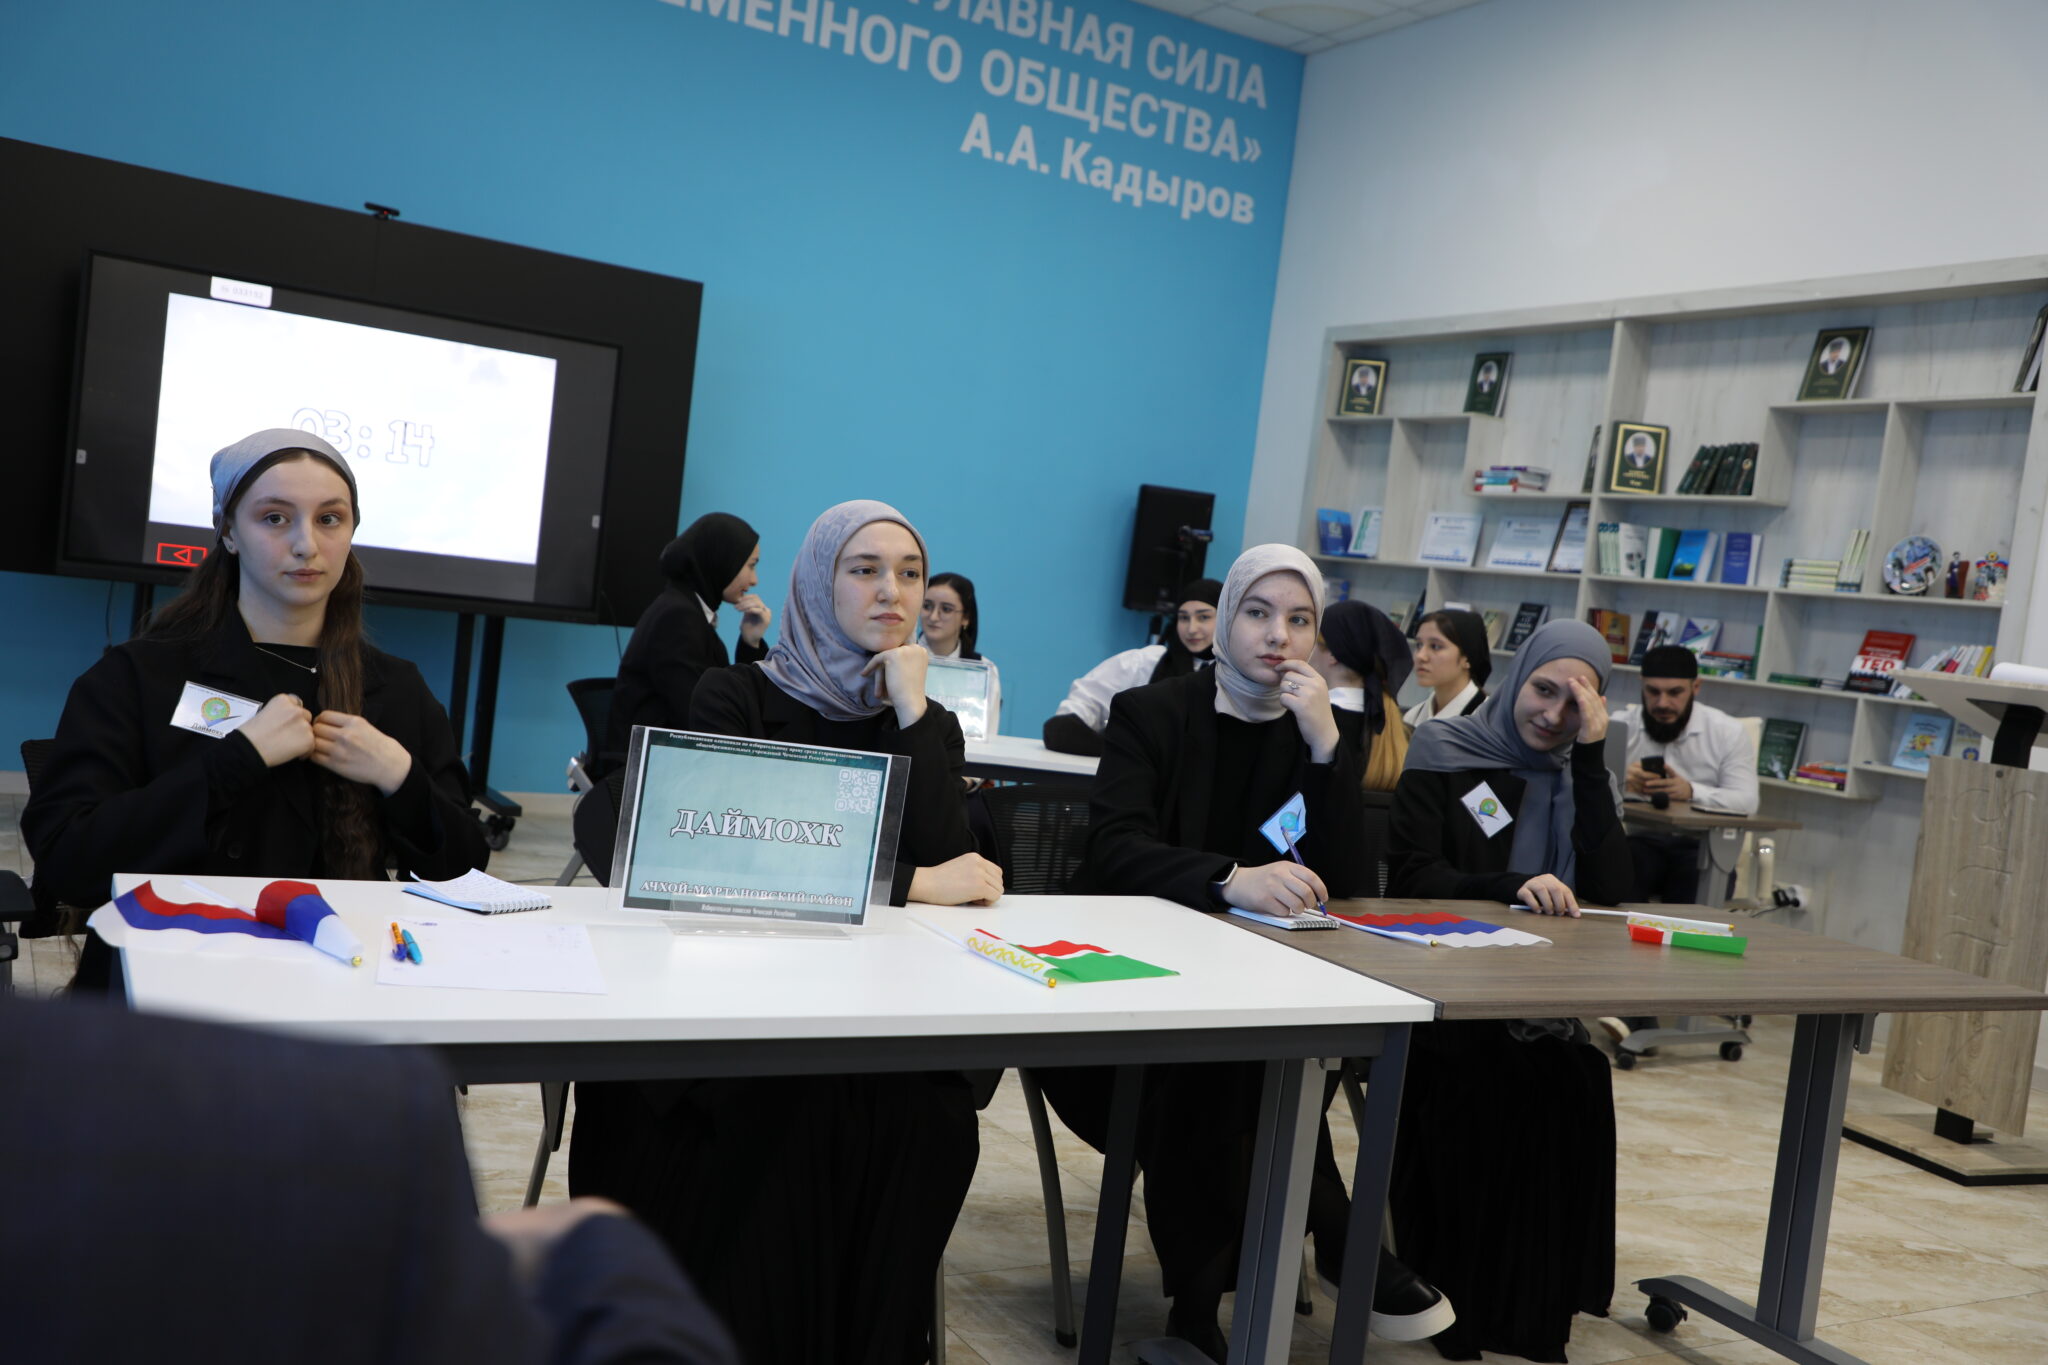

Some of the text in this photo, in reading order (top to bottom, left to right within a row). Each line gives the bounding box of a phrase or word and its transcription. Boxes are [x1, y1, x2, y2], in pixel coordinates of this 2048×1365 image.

[1146, 35, 1267, 109] СИЛА
[980, 49, 1263, 163] ОБЩЕСТВА»
[960, 111, 1256, 225] А.А. Кадыров
[1860, 656, 1895, 672] TED
[669, 808, 844, 848] ДАЙМОХК
[640, 880, 854, 908] АЧХОЙ-МАРТАНОВСКИЙ РАЙОН
